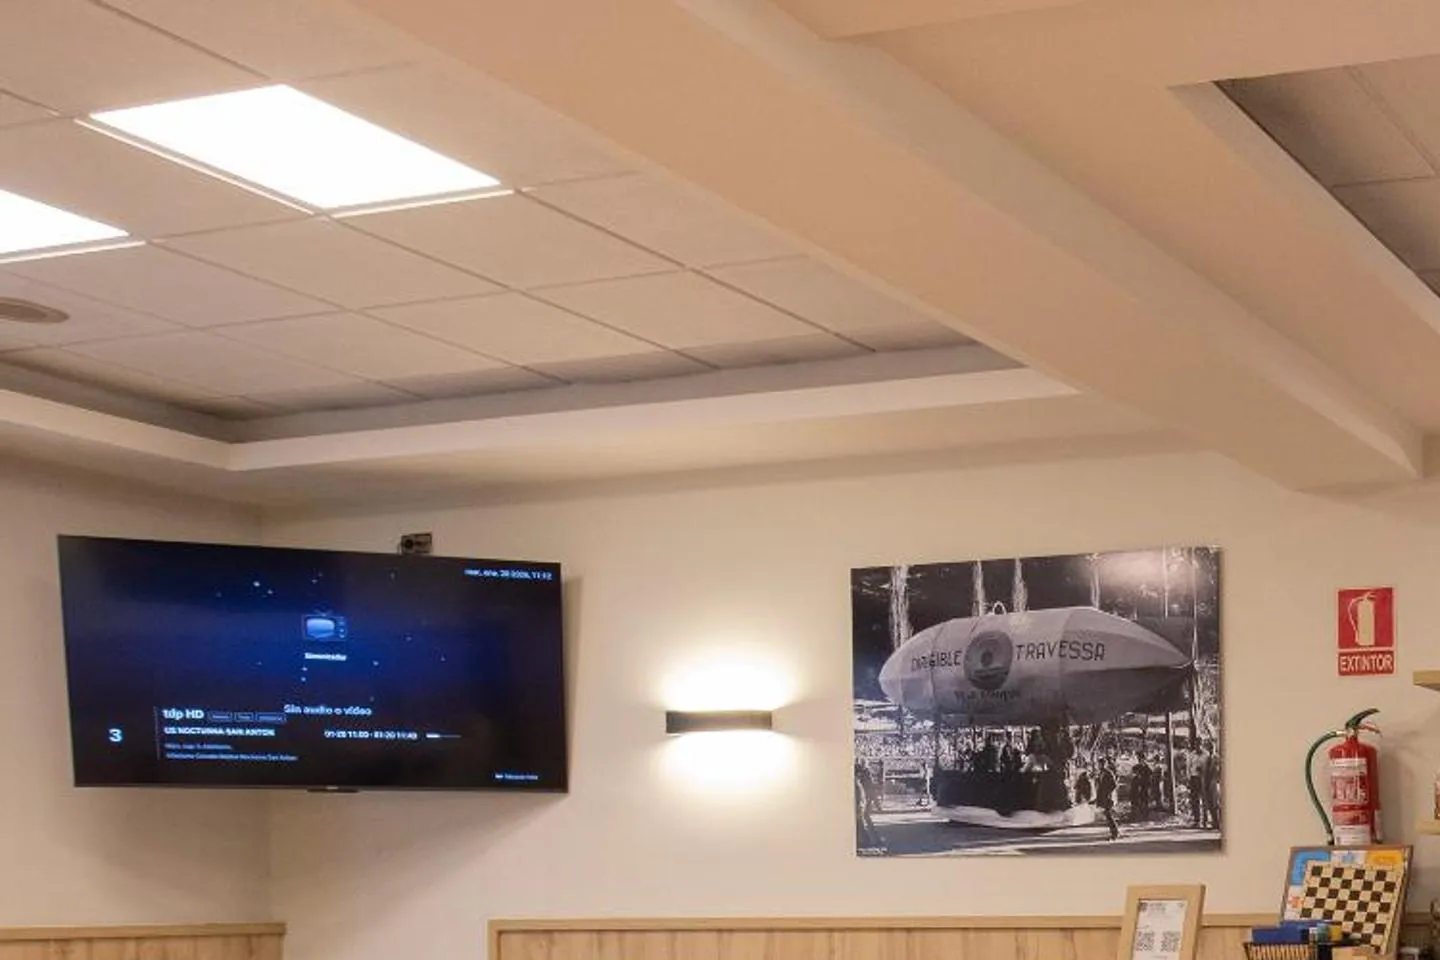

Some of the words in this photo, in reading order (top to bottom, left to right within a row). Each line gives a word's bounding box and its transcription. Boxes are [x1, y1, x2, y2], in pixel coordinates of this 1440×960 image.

[1016, 639, 1105, 661] TRAVESSA
[1340, 654, 1393, 672] EXTINTOR
[162, 709, 184, 721] tdp
[186, 709, 205, 719] HD
[108, 728, 123, 742] 3
